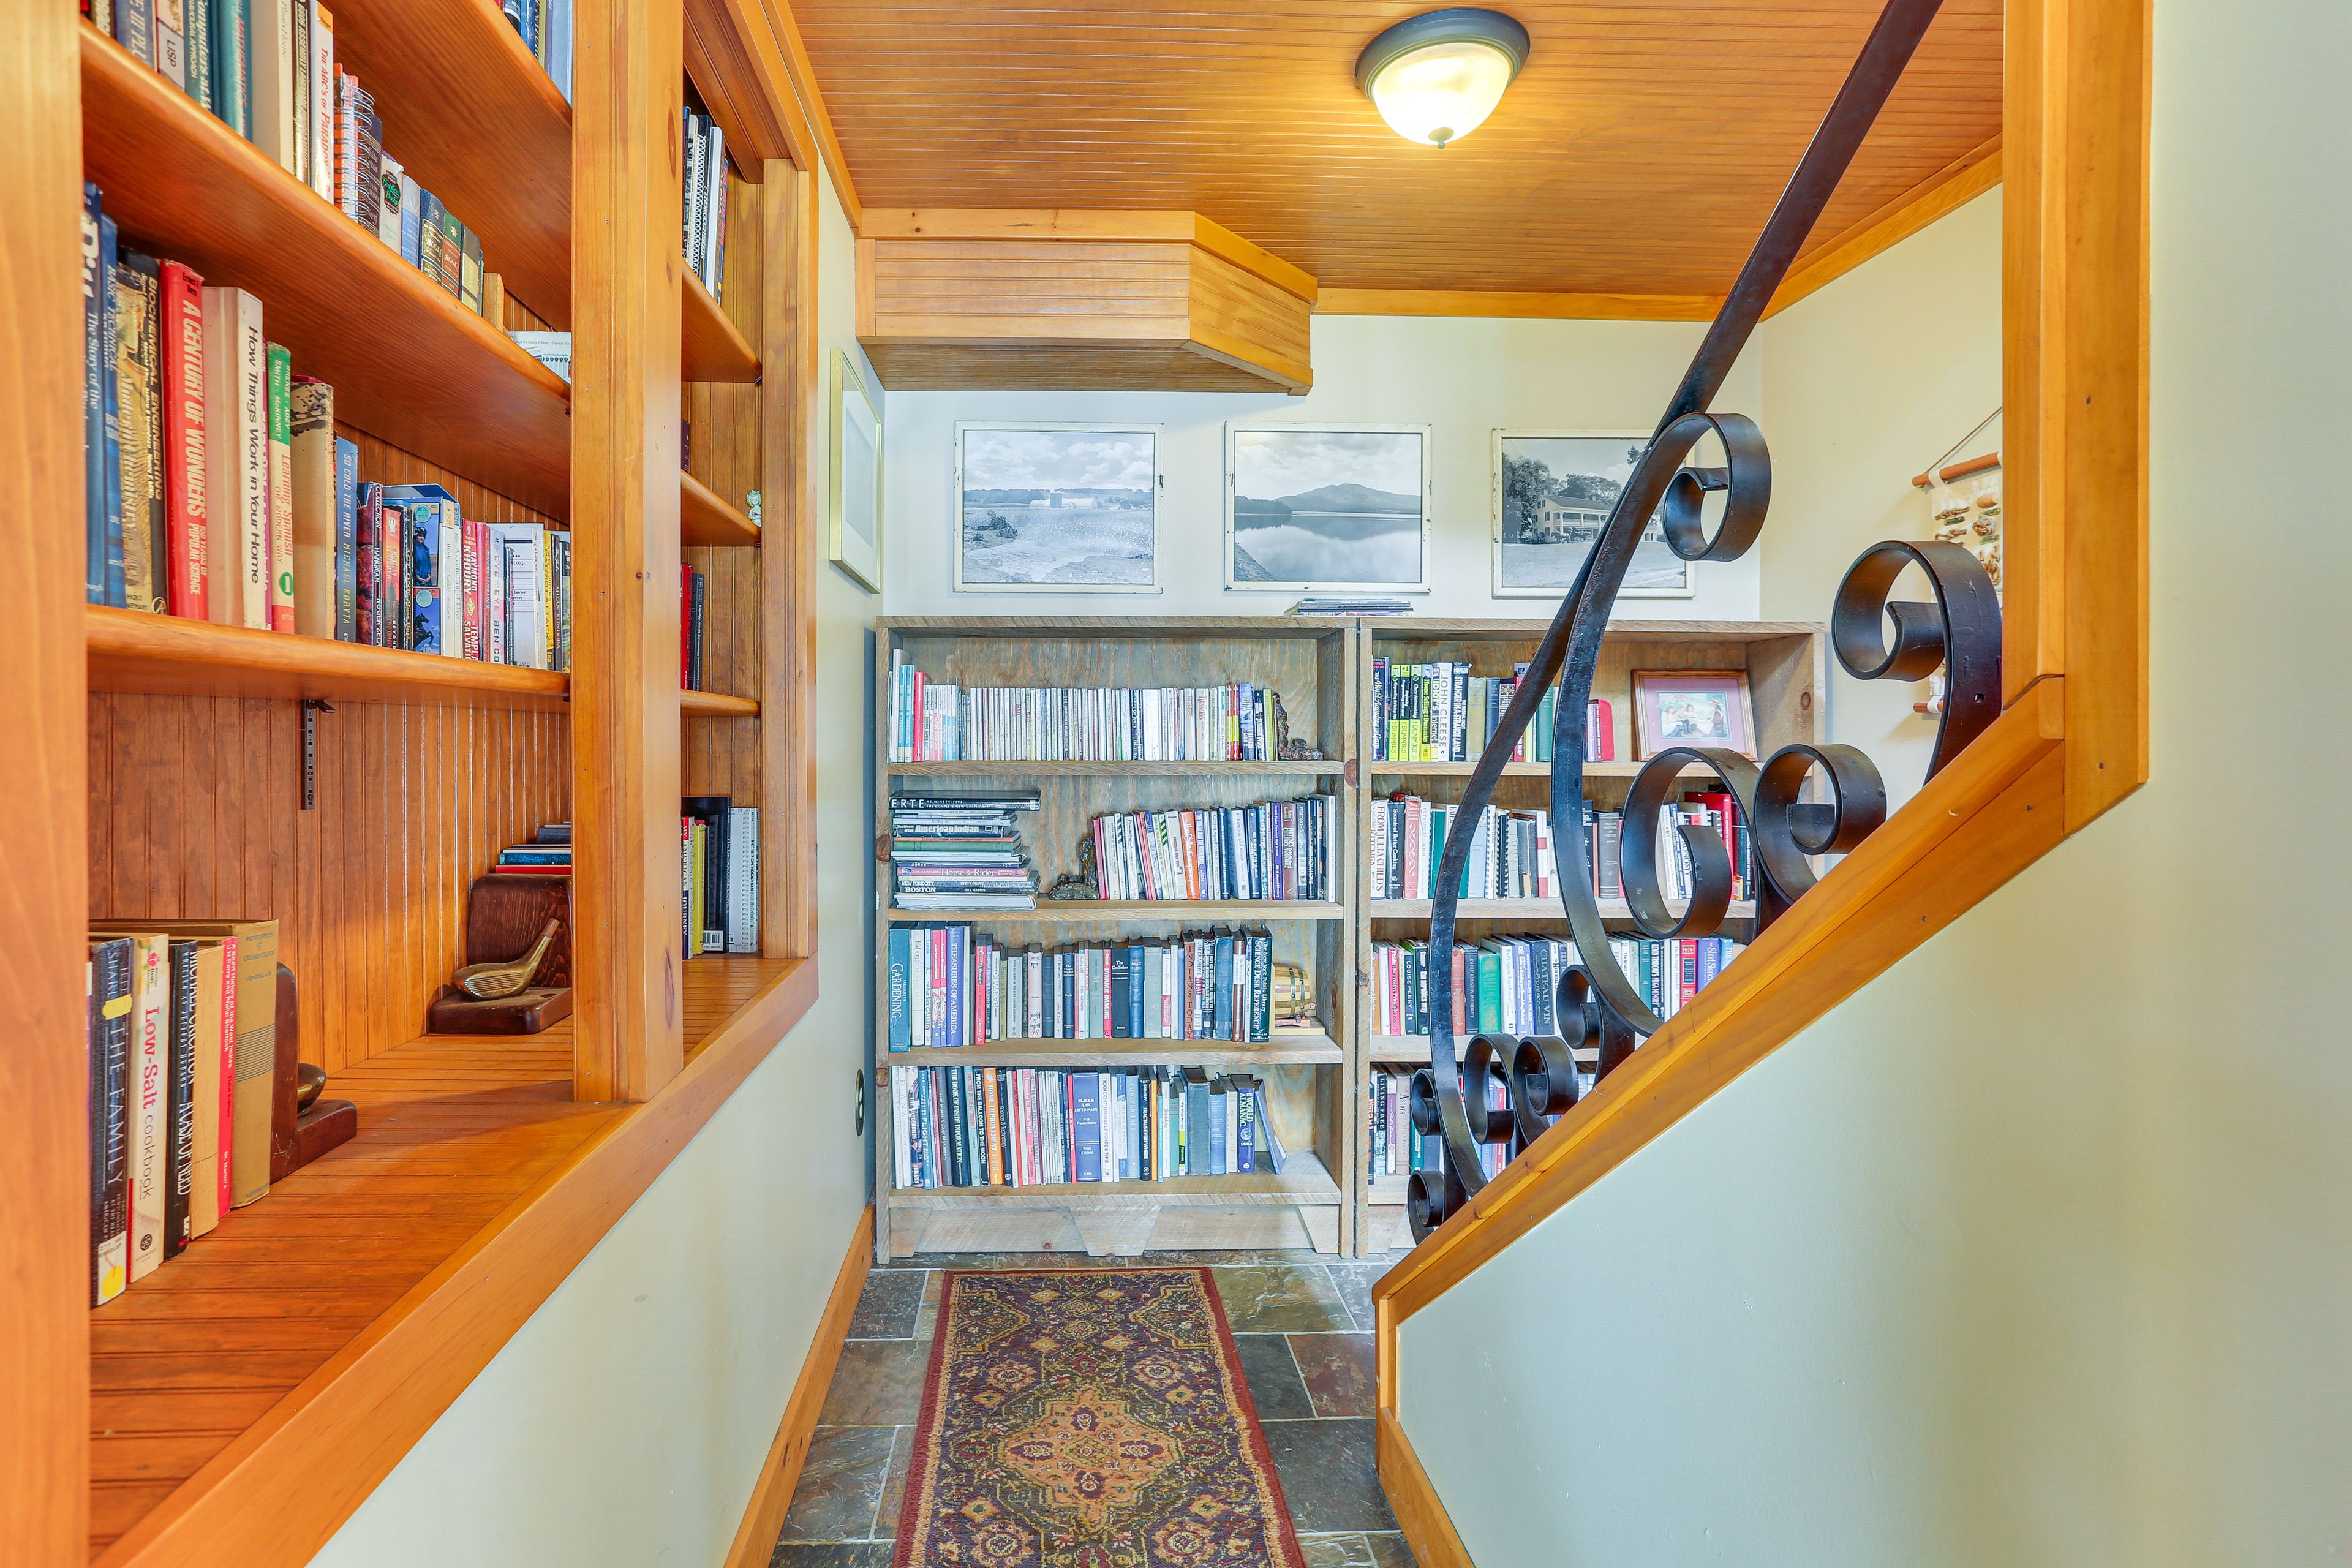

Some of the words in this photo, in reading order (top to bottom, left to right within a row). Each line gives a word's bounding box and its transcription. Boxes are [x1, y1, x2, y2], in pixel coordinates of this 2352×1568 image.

[167, 40, 176, 67] LISP
[88, 312, 99, 330] The
[183, 300, 201, 318] A
[87, 331, 99, 364] Story
[149, 276, 158, 385] BIOCHEMICAL
[249, 326, 258, 366] How
[183, 318, 204, 404] CENTURY
[89, 374, 99, 387] of
[247, 372, 258, 422] Things
[90, 389, 99, 409] the
[186, 402, 204, 426] OF
[151, 391, 162, 500] ENGINEERING
[249, 429, 258, 471] Work
[344, 454, 352, 466] SO
[186, 429, 206, 518] WONDERS
[250, 476, 258, 489] in
[281, 454, 291, 505] Learning
[251, 495, 259, 530] Your
[189, 522, 199, 560] POPULAR
[283, 510, 293, 556] Spanish
[189, 562, 200, 595] SCIENCE
[682, 825, 687, 837] MY
[915, 824, 954, 833] American
[955, 824, 979, 833] Indian
[1374, 833, 1385, 858] JULIA
[1706, 947, 1717, 962] Short
[1706, 962, 1717, 981] Stories
[891, 963, 904, 1019] GARDENING
[1540, 949, 1550, 1001] CHATEAU
[181, 995, 187, 1005] AS
[951, 989, 957, 999] OF
[1253, 990, 1261, 1030] REFERENCE
[110, 1022, 126, 1075] THE
[143, 1006, 160, 1109] Low-Salt
[179, 1102, 194, 1114] A
[107, 1088, 125, 1185] FAMILY
[178, 1112, 194, 1144] CASE
[954, 1123, 963, 1163] INFORMATION
[989, 1105, 997, 1151] IMPROVEMENT
[142, 1115, 156, 1199] cookbook
[178, 1143, 193, 1161] OF
[177, 1162, 192, 1196] NEED
